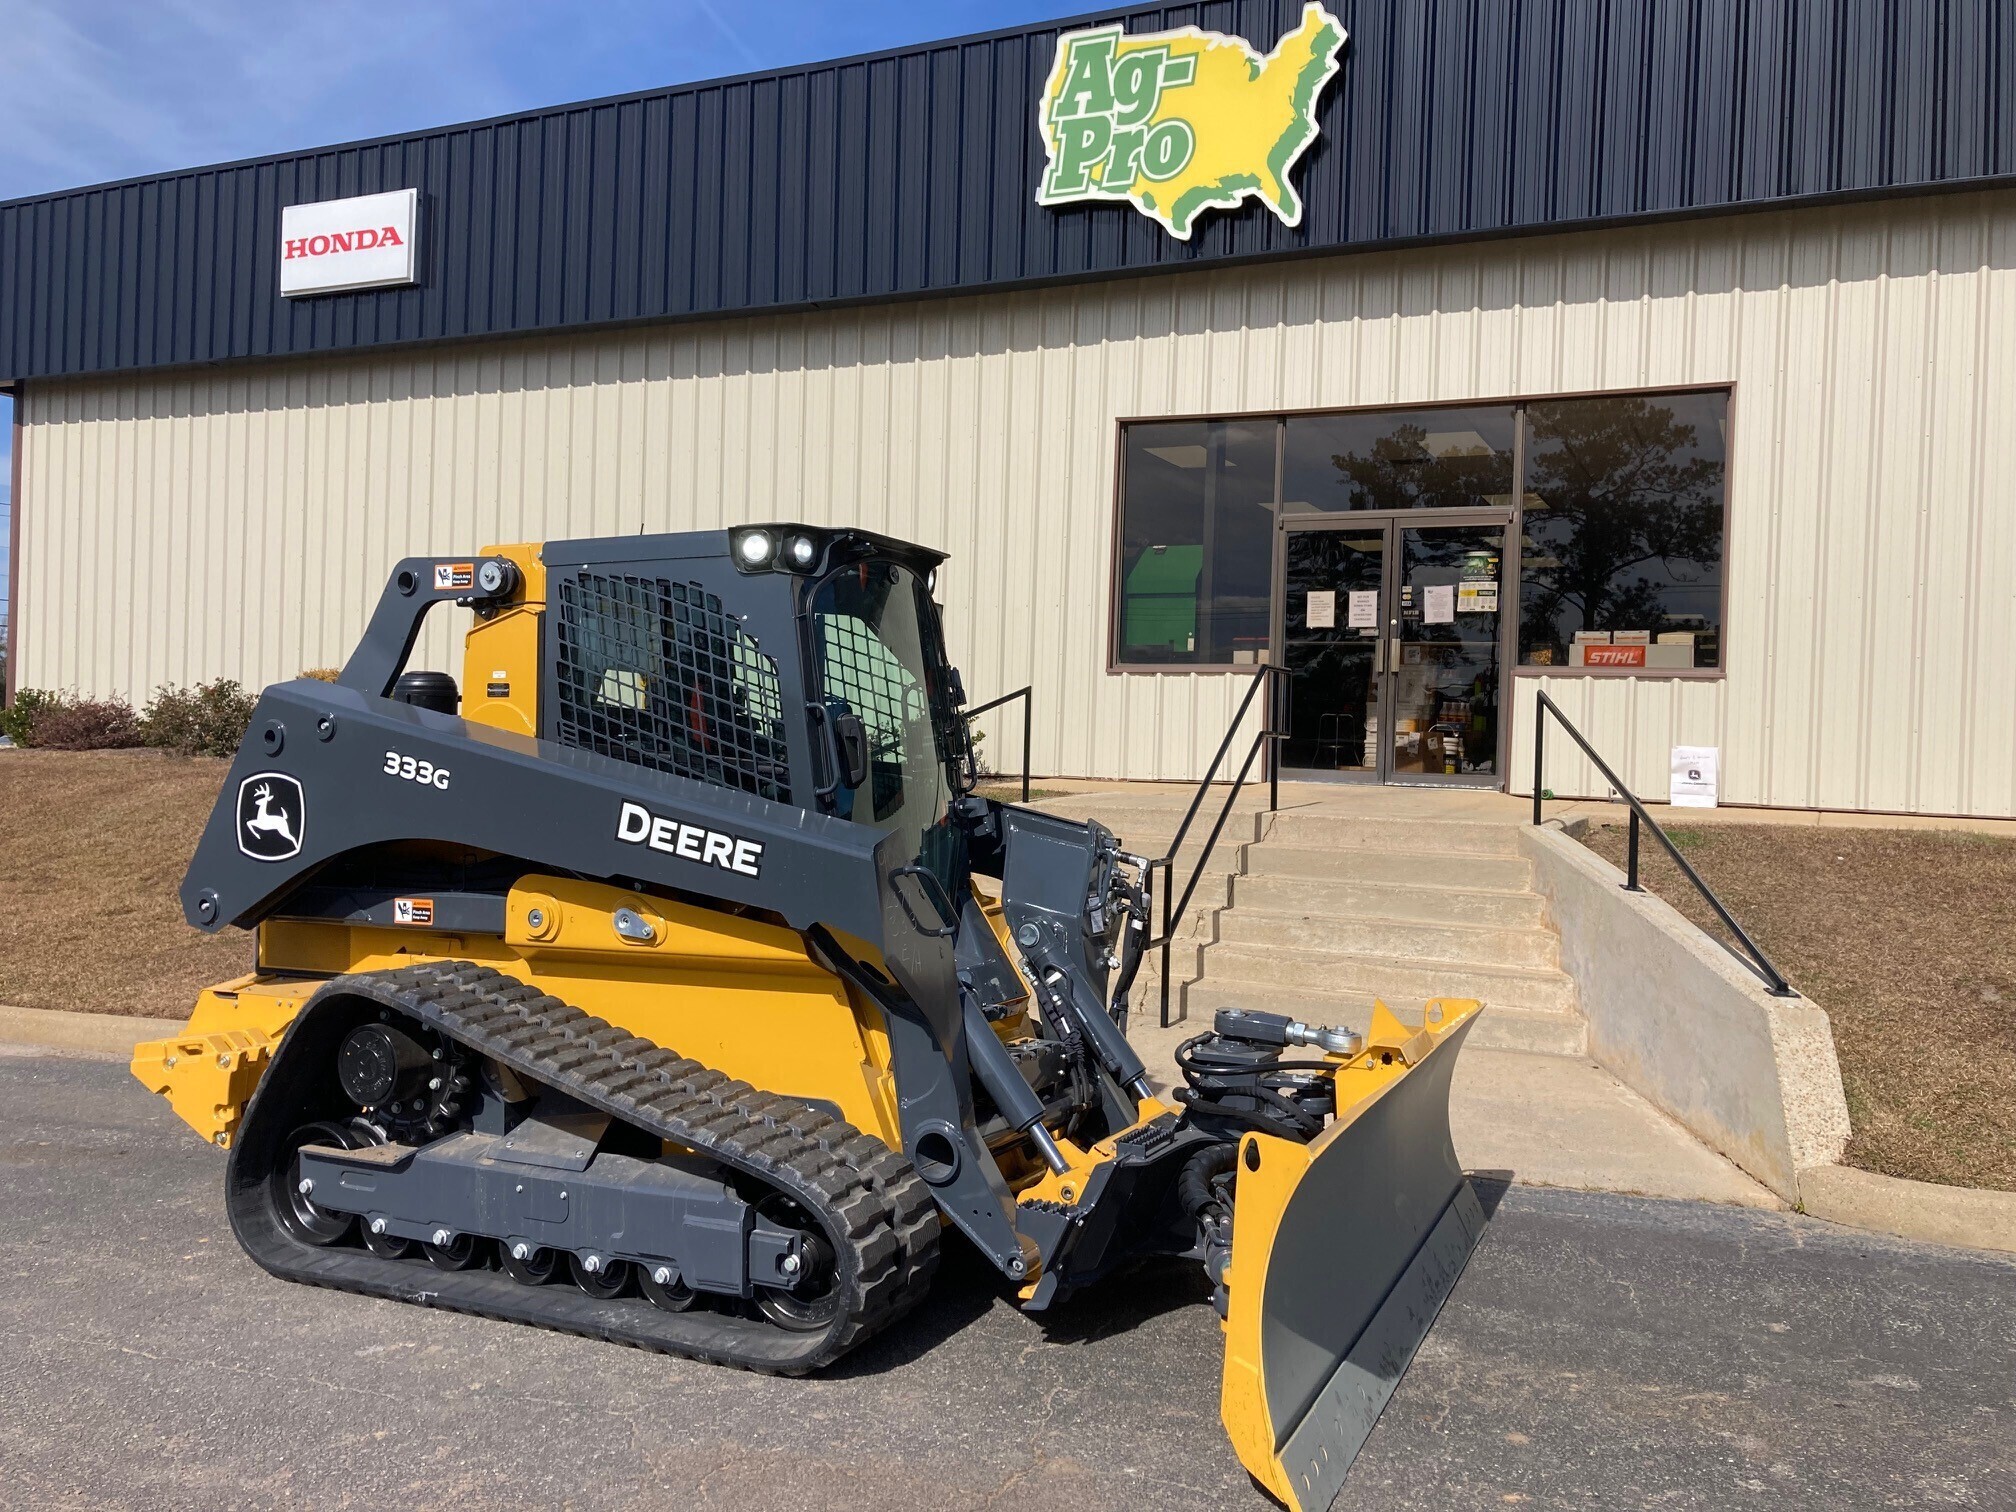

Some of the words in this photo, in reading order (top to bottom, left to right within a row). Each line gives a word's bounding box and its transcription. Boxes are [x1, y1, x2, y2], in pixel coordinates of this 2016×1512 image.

[1050, 34, 1197, 127] Ag-
[1048, 115, 1195, 197] Pro
[285, 226, 404, 259] HONDA
[1588, 652, 1638, 664] STIHL
[383, 751, 451, 790] 333G
[617, 801, 763, 876] DEERE
